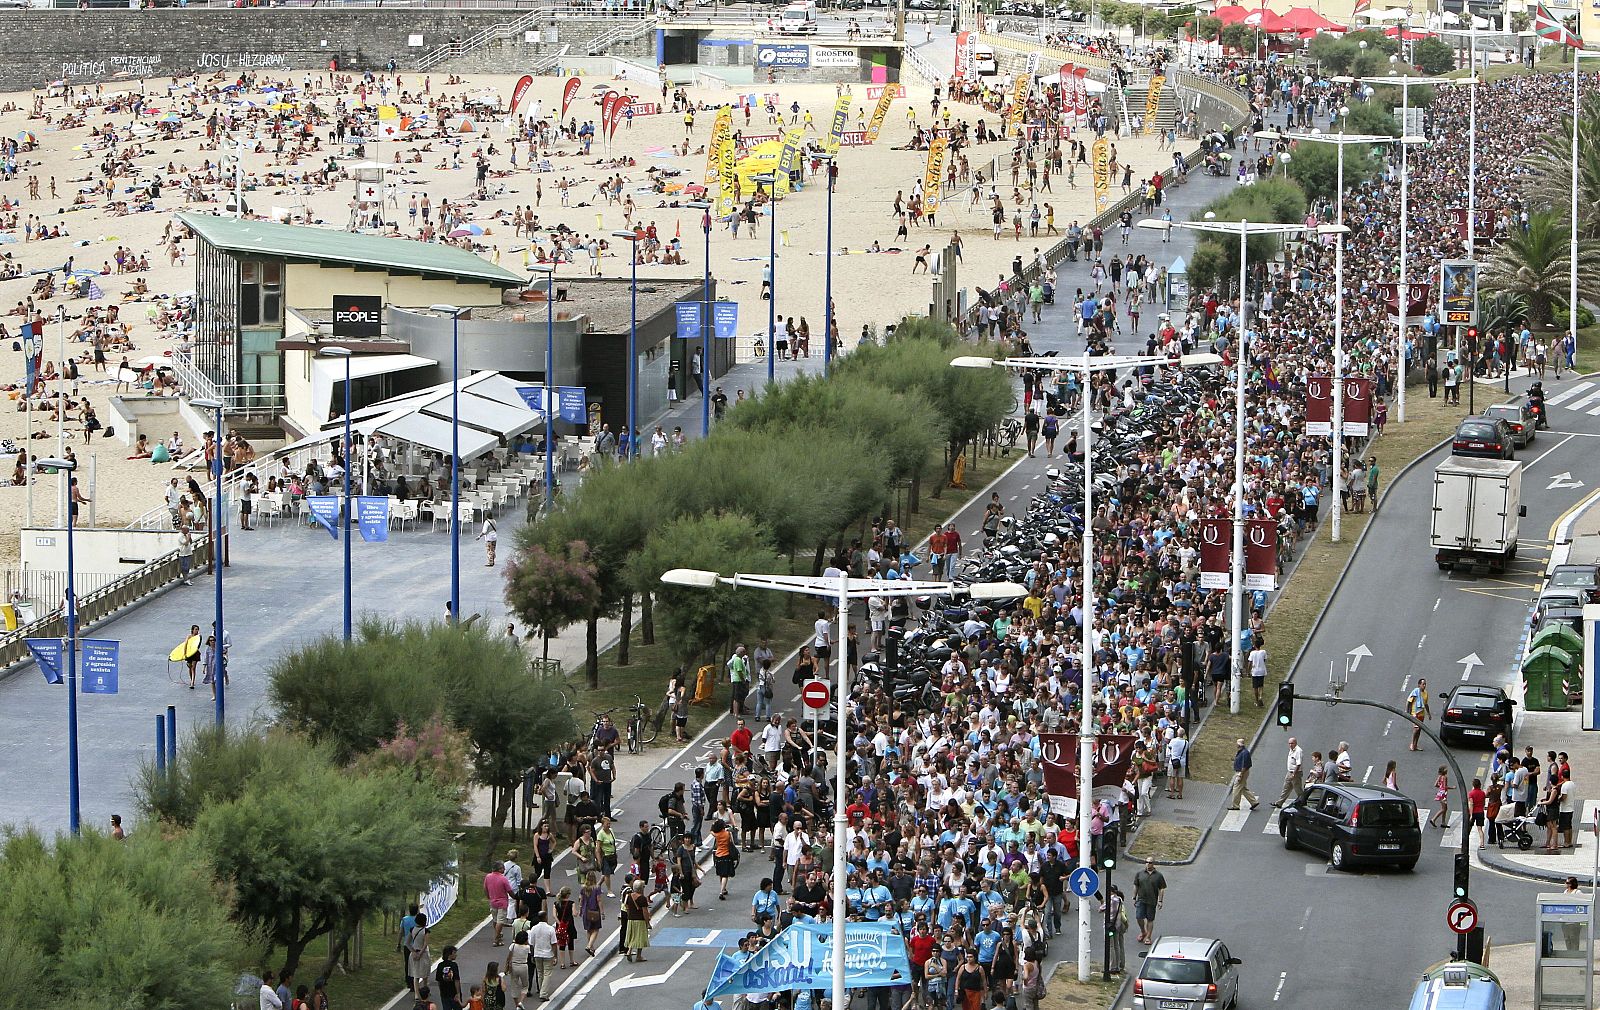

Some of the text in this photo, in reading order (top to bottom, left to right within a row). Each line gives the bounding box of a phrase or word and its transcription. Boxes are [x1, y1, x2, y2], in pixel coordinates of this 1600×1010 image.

[197, 52, 229, 68] JOSU
[1151, 80, 1162, 117] Schuss
[721, 149, 734, 194] Schuss
[926, 145, 944, 191] Schuss
[1097, 145, 1109, 190] Schuss
[336, 311, 378, 322] PEOPLE
